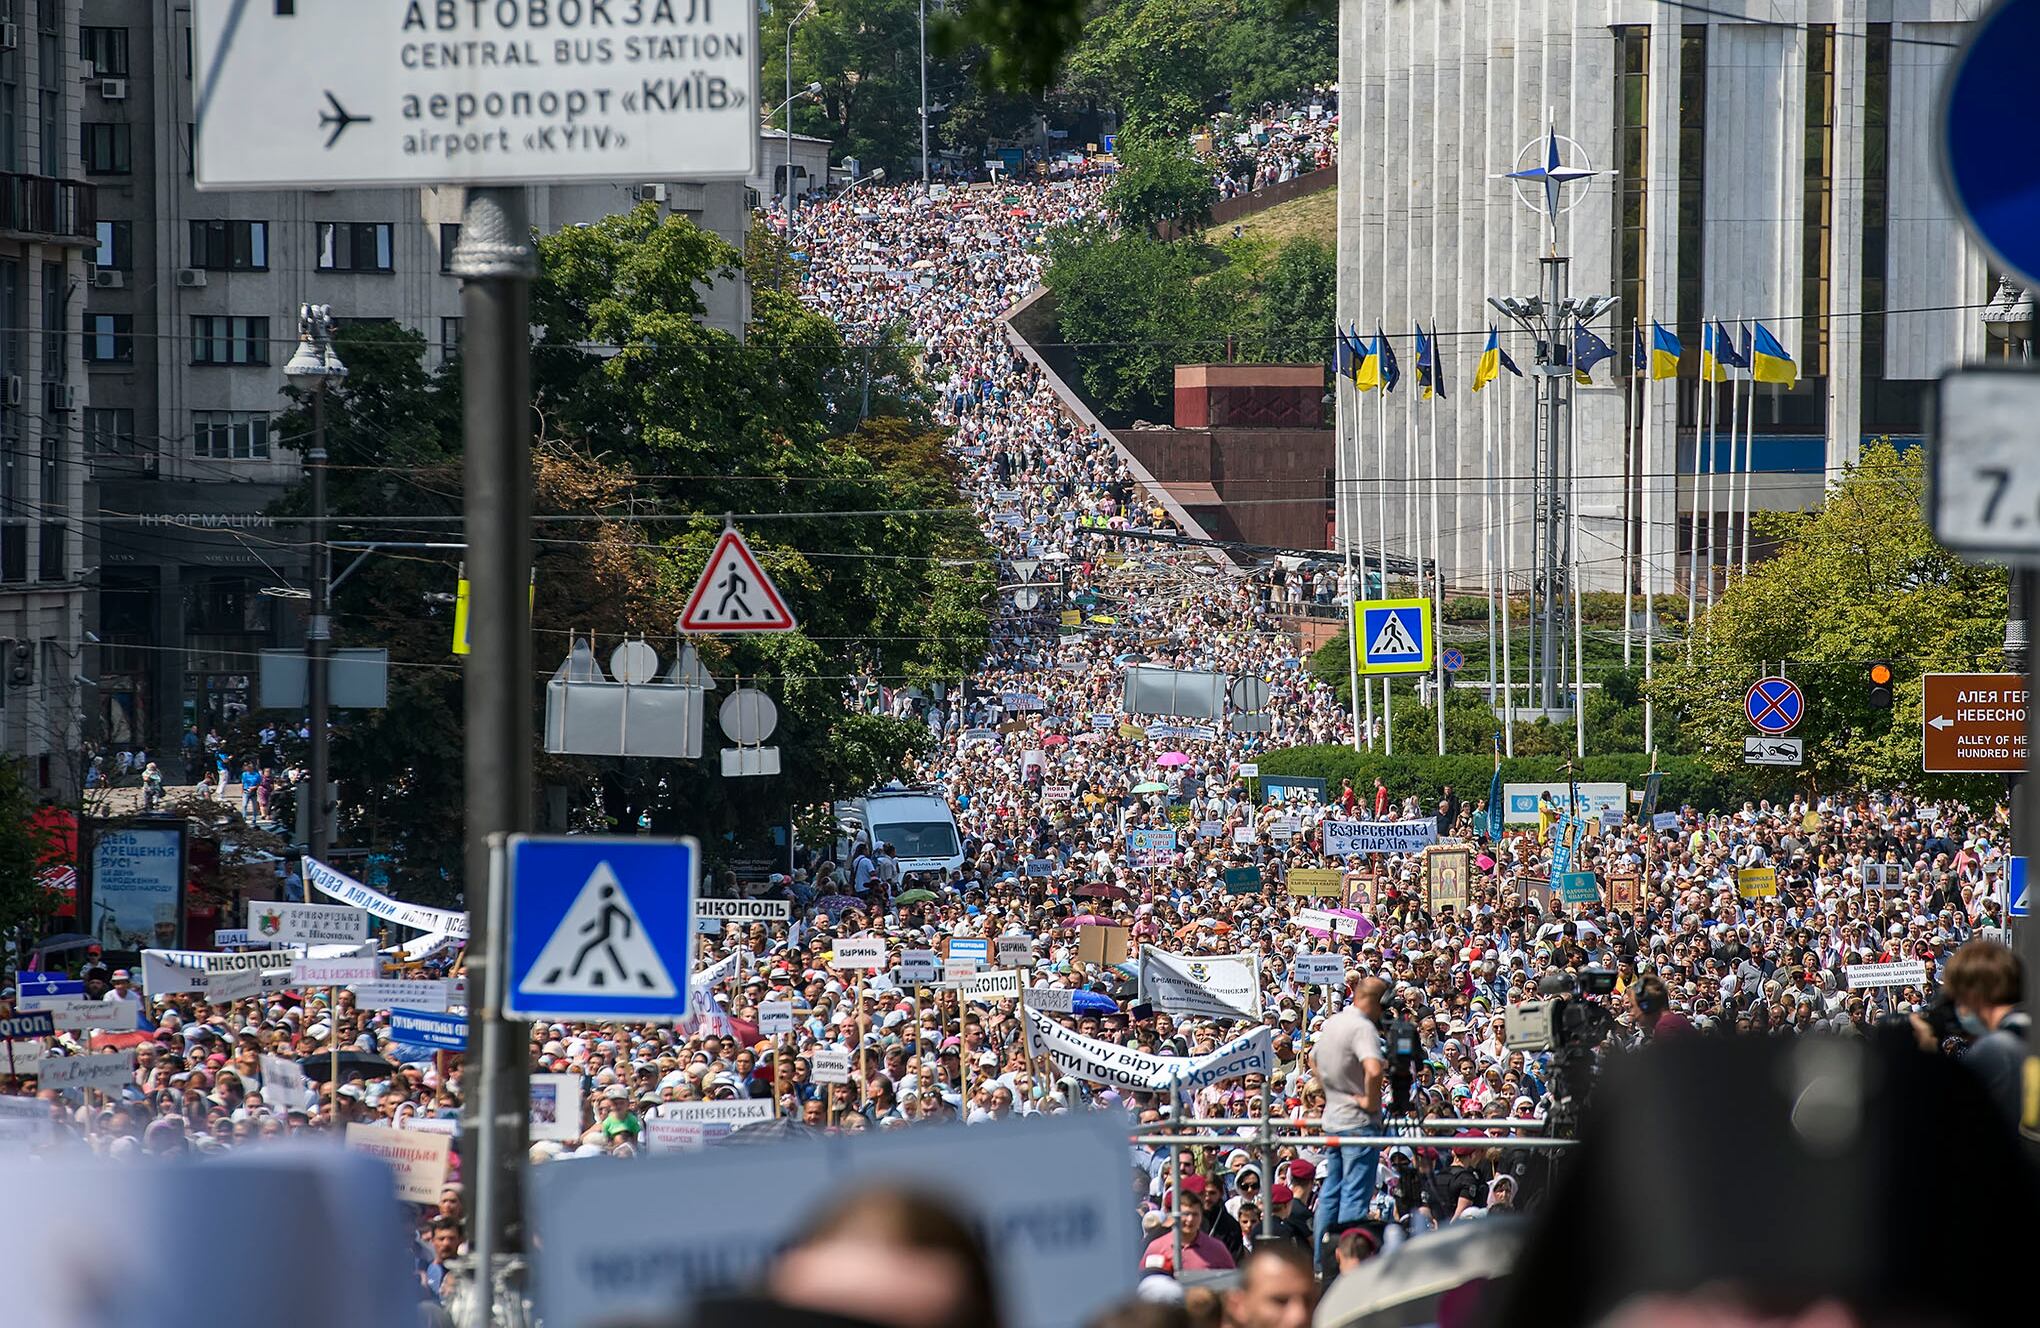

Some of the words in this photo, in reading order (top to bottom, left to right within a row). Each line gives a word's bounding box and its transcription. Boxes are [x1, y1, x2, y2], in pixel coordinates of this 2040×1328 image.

[402, 0, 712, 31] АВТОВОКЗАЛ
[401, 43, 539, 69] CENTRAL
[554, 40, 614, 64] BUS
[625, 35, 744, 62] STATION
[402, 89, 611, 125] аеропорт
[621, 70, 746, 114] «КИЇВ»
[402, 128, 509, 157] airport
[522, 126, 627, 151] «KYIV»
[1957, 691, 1998, 703] АЛЕЯ
[2004, 691, 2031, 703] ГЕР
[1957, 735, 1992, 745] ALLEY
[1995, 735, 2010, 745] OF
[2013, 735, 2028, 745] HE
[1957, 749, 2009, 758] HUNDRED
[101, 833, 137, 845] ДЕНЬ
[1351, 838, 1408, 851] ЄПАРХІЯ
[102, 846, 175, 857] ХРЕЩЕННЯ
[101, 858, 131, 868] РУСІ
[344, 887, 397, 917] людини
[696, 901, 787, 917] НІКОПОЛЬ
[839, 948, 878, 957] БУРИНЬ
[1000, 941, 1028, 952] БУРИНЬ
[207, 952, 291, 971] НІКОПОЛЬ
[904, 957, 931, 966] БУРИНЬ
[1314, 964, 1339, 973] БУРИНЬ
[966, 976, 1025, 994] КОПОЛ
[1024, 988, 1069, 1000] ОМЕНСЬКА
[762, 1013, 790, 1021] БУРИНЬ
[1031, 1012, 1053, 1035] За
[1057, 1030, 1116, 1062] нашу
[1118, 1053, 1165, 1075] віру
[816, 1059, 845, 1069] БУРИНЬ
[1086, 1061, 1151, 1088] готові
[1188, 1051, 1266, 1087] Хреста!
